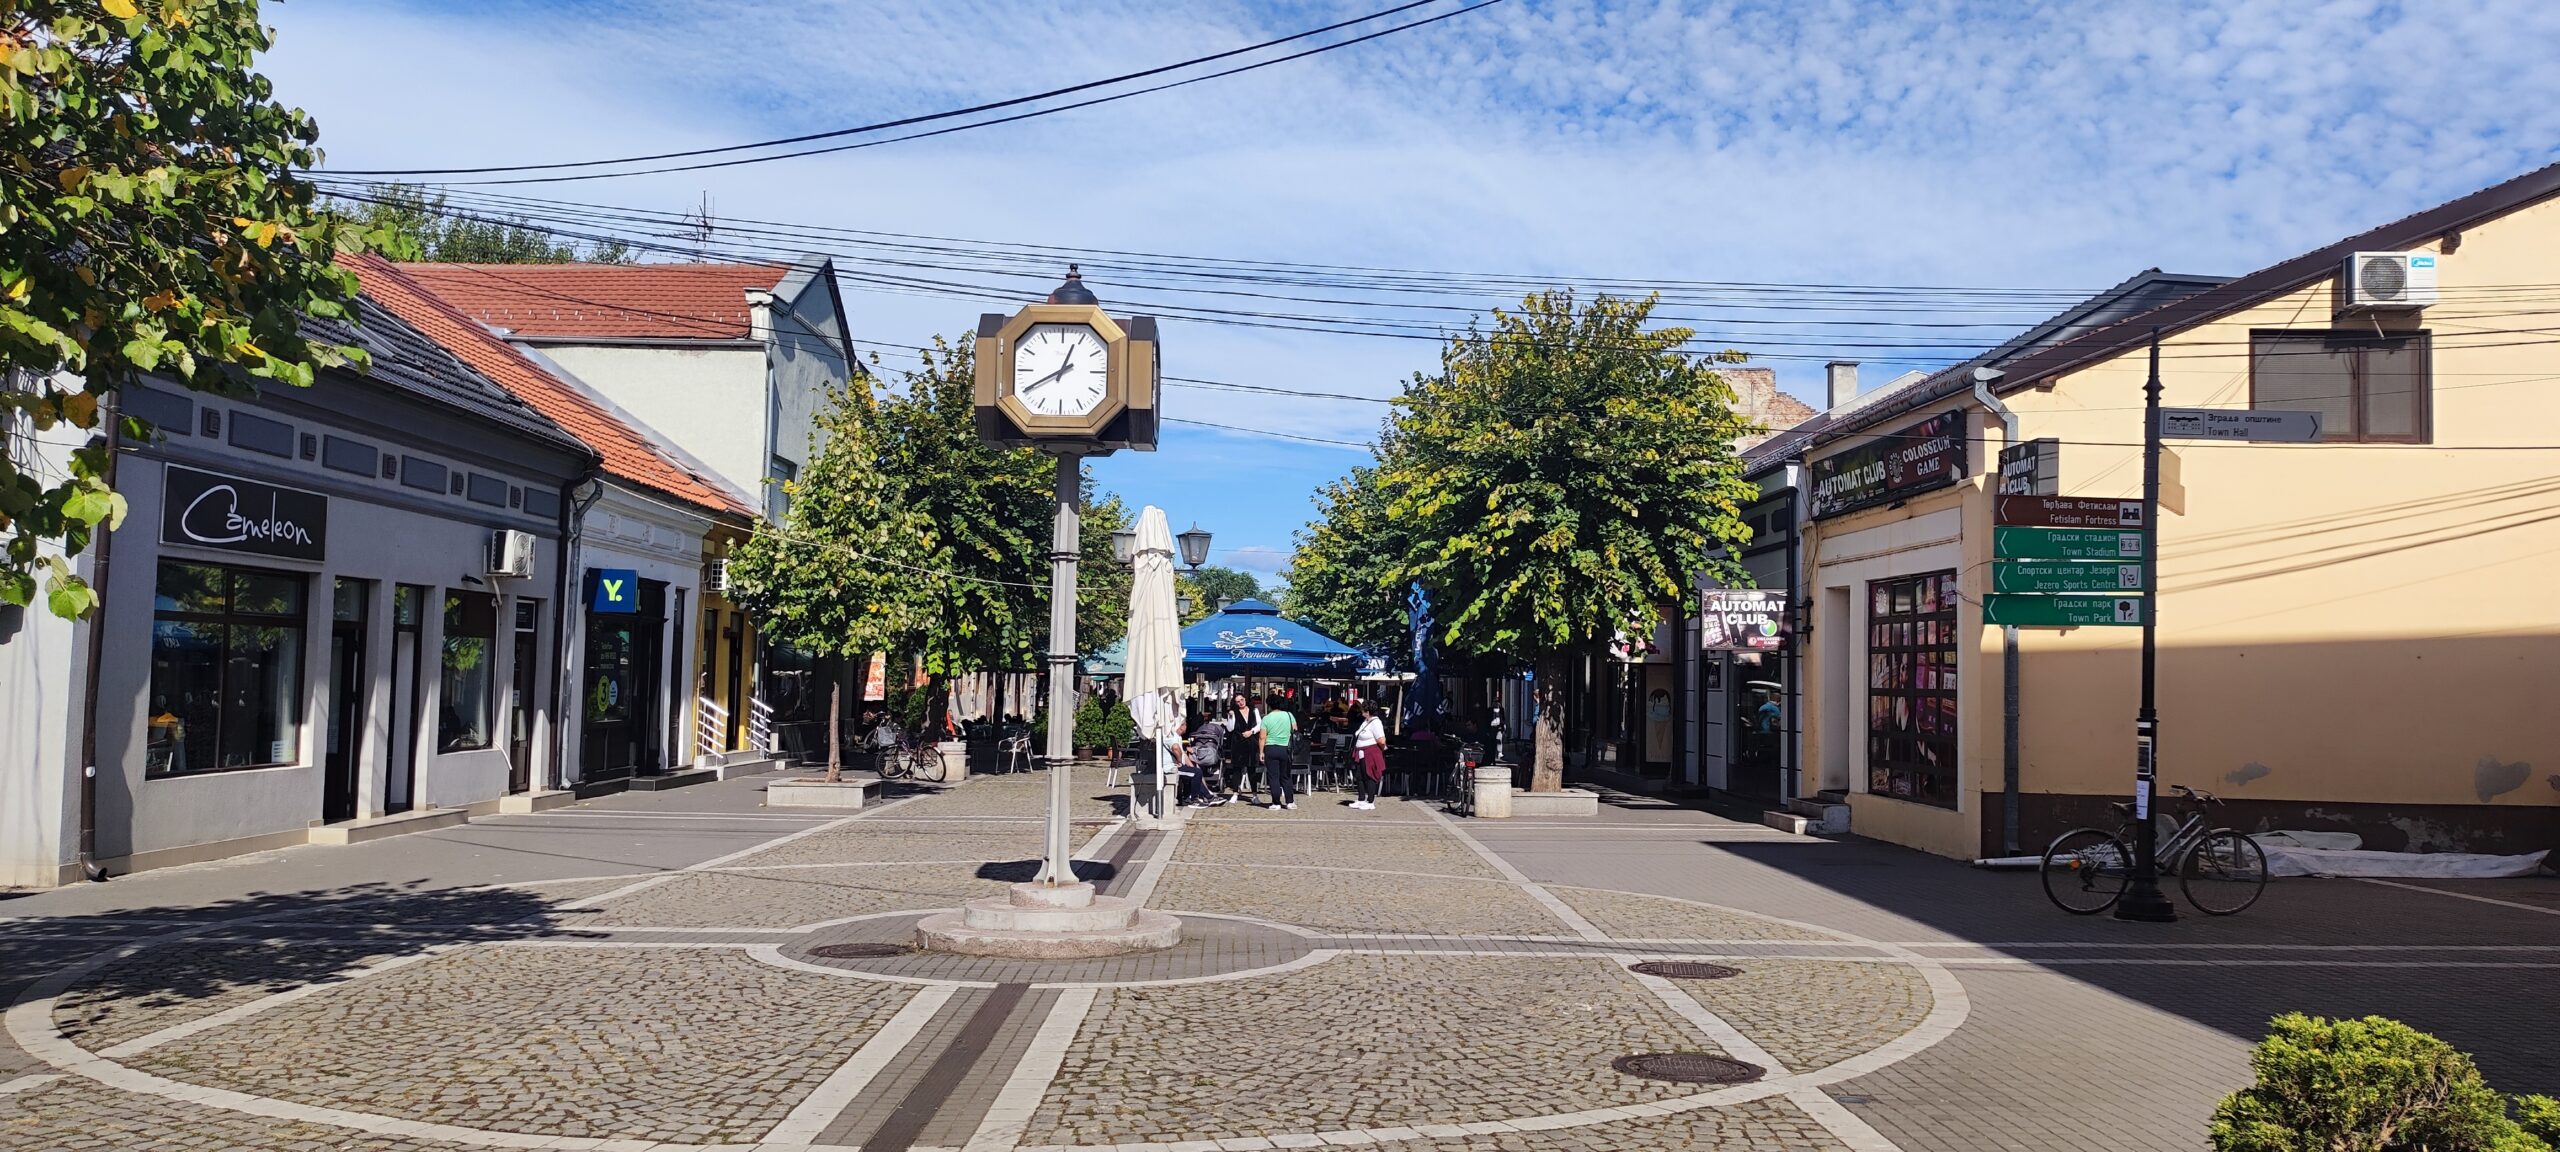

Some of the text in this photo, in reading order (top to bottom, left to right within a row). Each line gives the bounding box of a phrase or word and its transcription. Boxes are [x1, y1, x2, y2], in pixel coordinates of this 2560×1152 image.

[2207, 413, 2282, 424] Зграда општине
[2207, 426, 2249, 437] Town Hall
[1902, 435, 1951, 463] COLOSSEUM
[1916, 456, 1941, 476] GAME
[2002, 456, 2036, 478] AUTOMAT
[1818, 468, 1862, 499] AUTOMAT
[1863, 460, 1886, 485] CLUB
[2009, 476, 2028, 494] CLUB
[2042, 499, 2117, 511] Тврђава Фетислам
[181, 484, 312, 546] Cameleon
[2050, 514, 2117, 525] Fetislam Fortress
[2047, 532, 2116, 543] Градски стадион
[2062, 547, 2116, 556] Town Stadium
[2017, 566, 2116, 576] Спортски центар Језеро
[2034, 580, 2116, 590] Jezero Sports Centre
[1710, 600, 1786, 612] AUTOMAT
[2053, 599, 2111, 609] Градски парк
[1726, 613, 1769, 625] CLUB
[2068, 613, 2112, 622] Town Park
[1231, 649, 1281, 660] Premium
